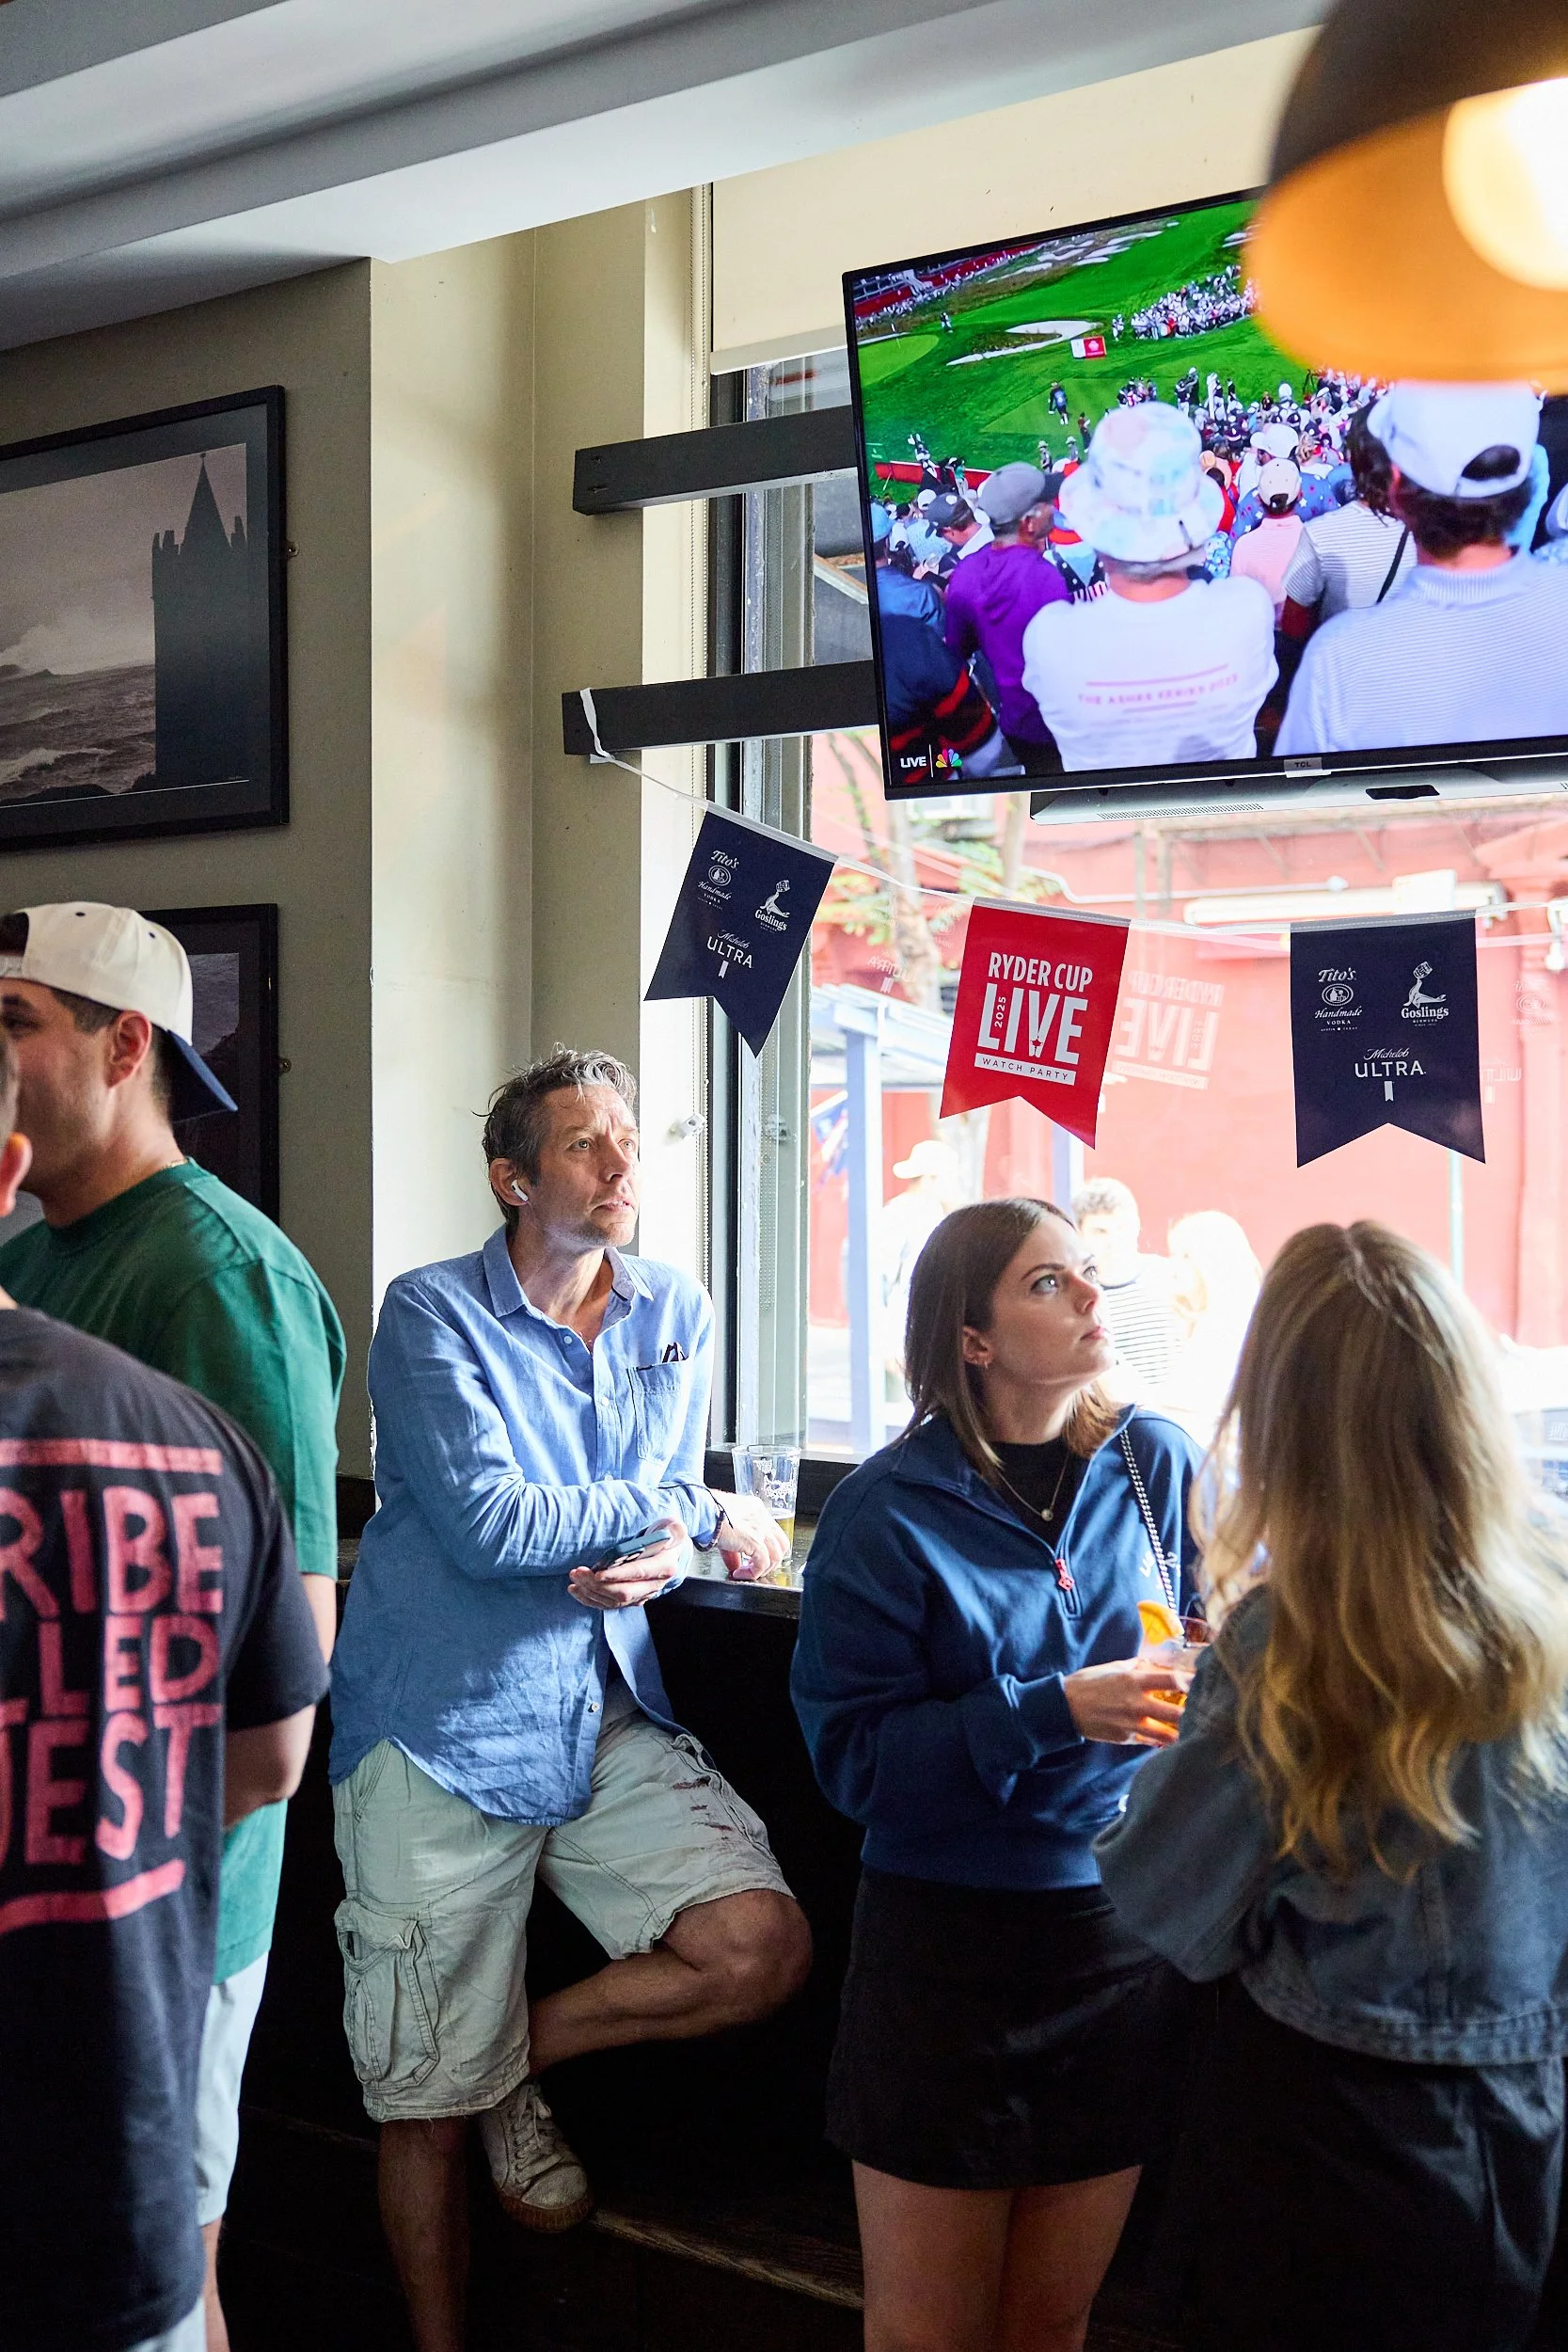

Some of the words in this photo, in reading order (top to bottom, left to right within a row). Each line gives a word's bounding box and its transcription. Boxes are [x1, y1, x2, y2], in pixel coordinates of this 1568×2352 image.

[900, 755, 927, 769] LIVE
[710, 850, 740, 870] Tito's
[697, 881, 733, 900] Handmade
[754, 909, 788, 931] Goslings
[706, 935, 753, 969] ULTRA
[988, 951, 1052, 987] RYDER
[1053, 962, 1094, 993] CUP
[1318, 966, 1356, 983] Tito's
[994, 996, 1006, 1028] 2025
[1314, 1005, 1363, 1019] Handmade
[1401, 1006, 1449, 1020] Goslings
[977, 982, 1089, 1066] LIVE
[1363, 1046, 1410, 1060] Michelob
[981, 1057, 1023, 1072] WATCH
[1030, 1066, 1069, 1081] PARTY
[1354, 1059, 1425, 1078] ULTRA
